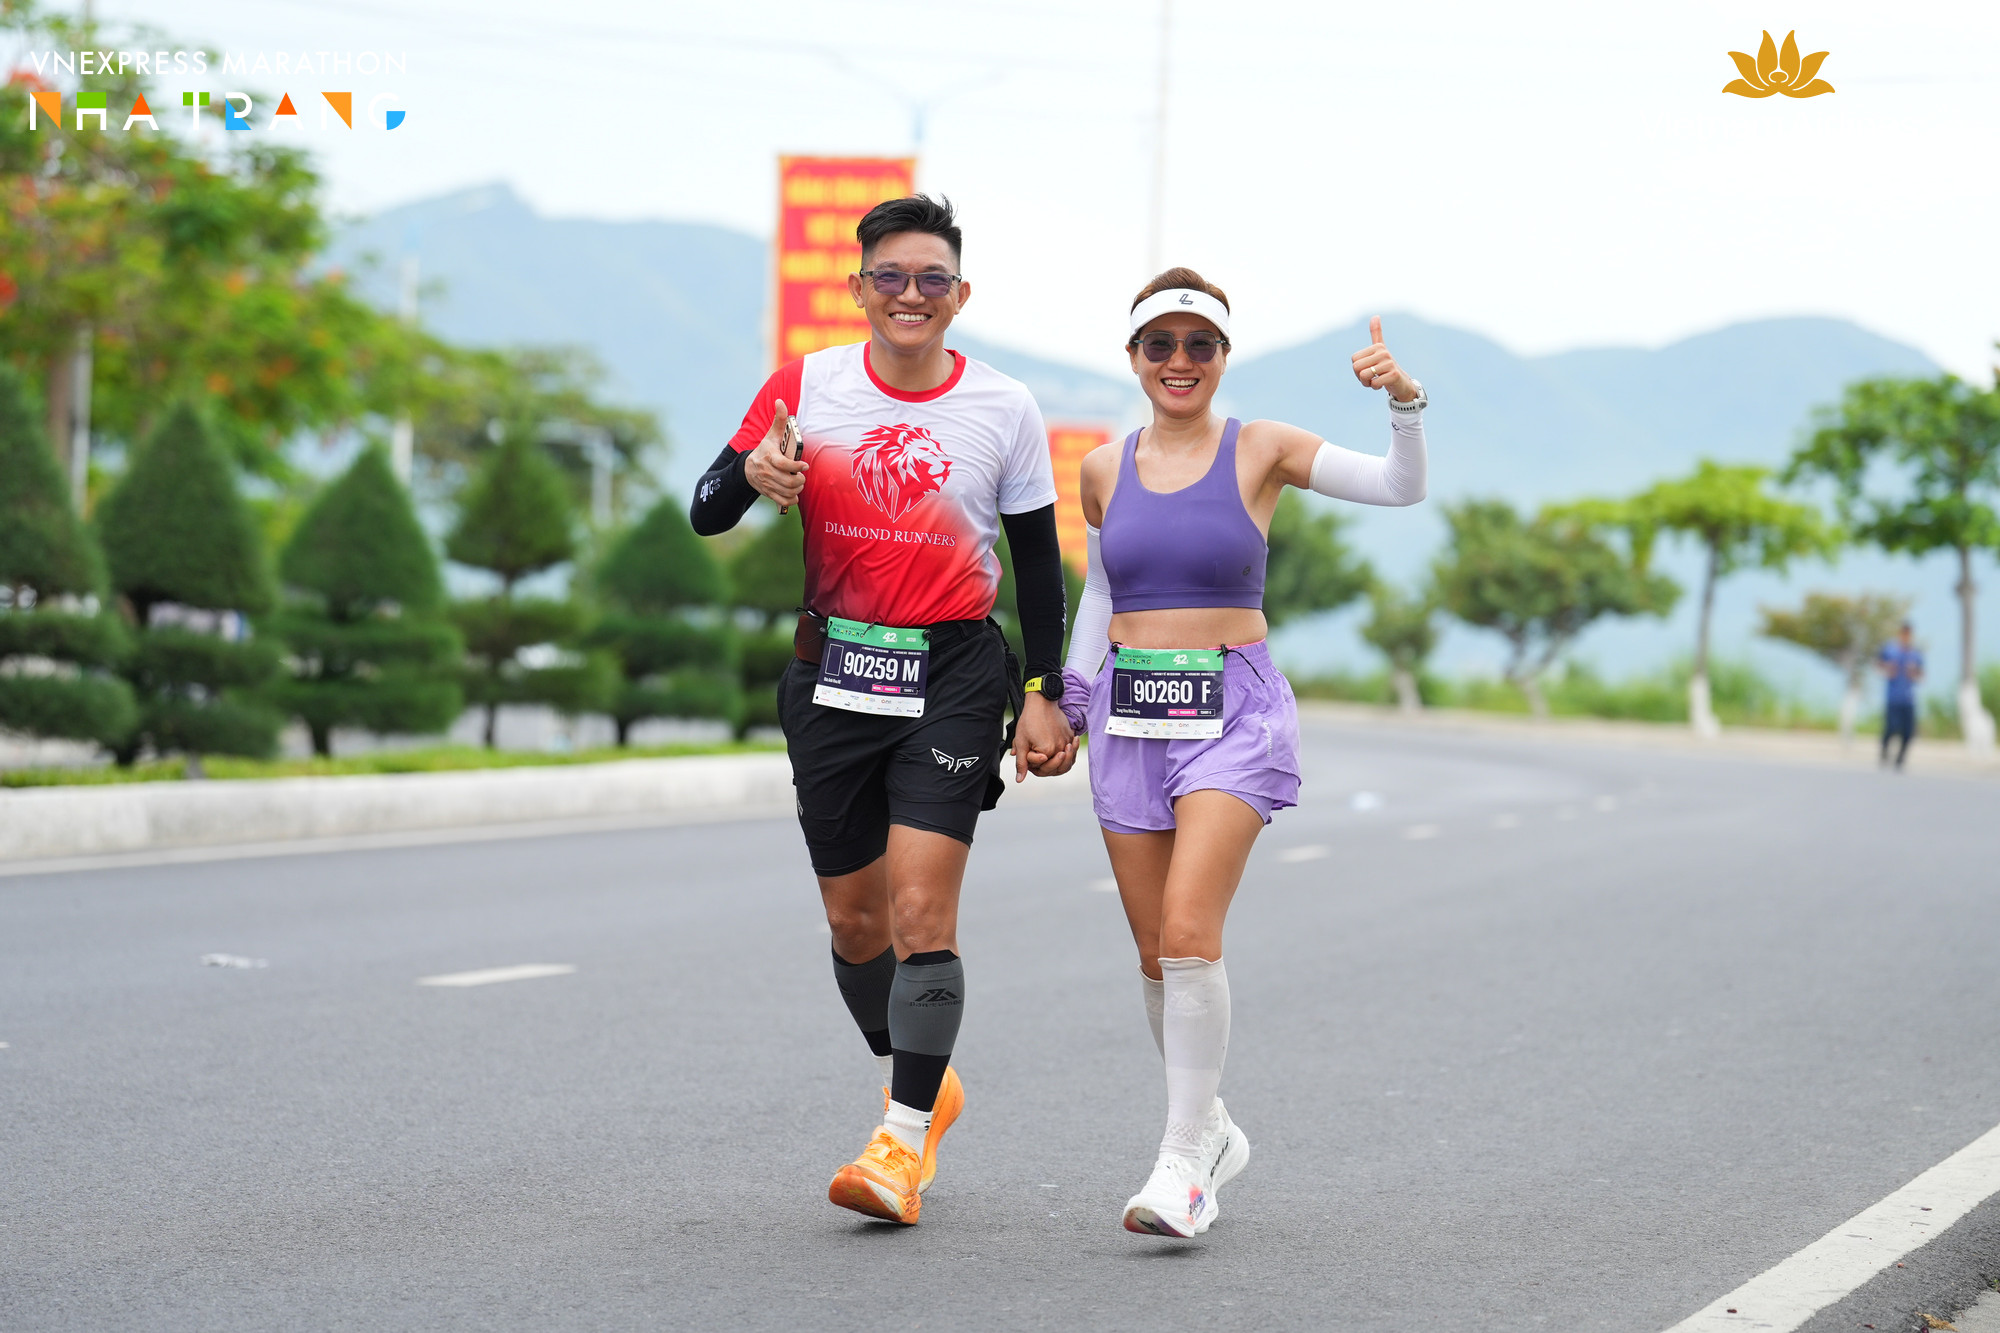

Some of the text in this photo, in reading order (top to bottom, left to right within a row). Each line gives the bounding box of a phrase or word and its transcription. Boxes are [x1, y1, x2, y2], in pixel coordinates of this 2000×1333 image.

[824, 521, 957, 547] DIAMOND RUNNERS
[843, 651, 921, 683] 90259 M
[1133, 680, 1211, 704] 90260 F
